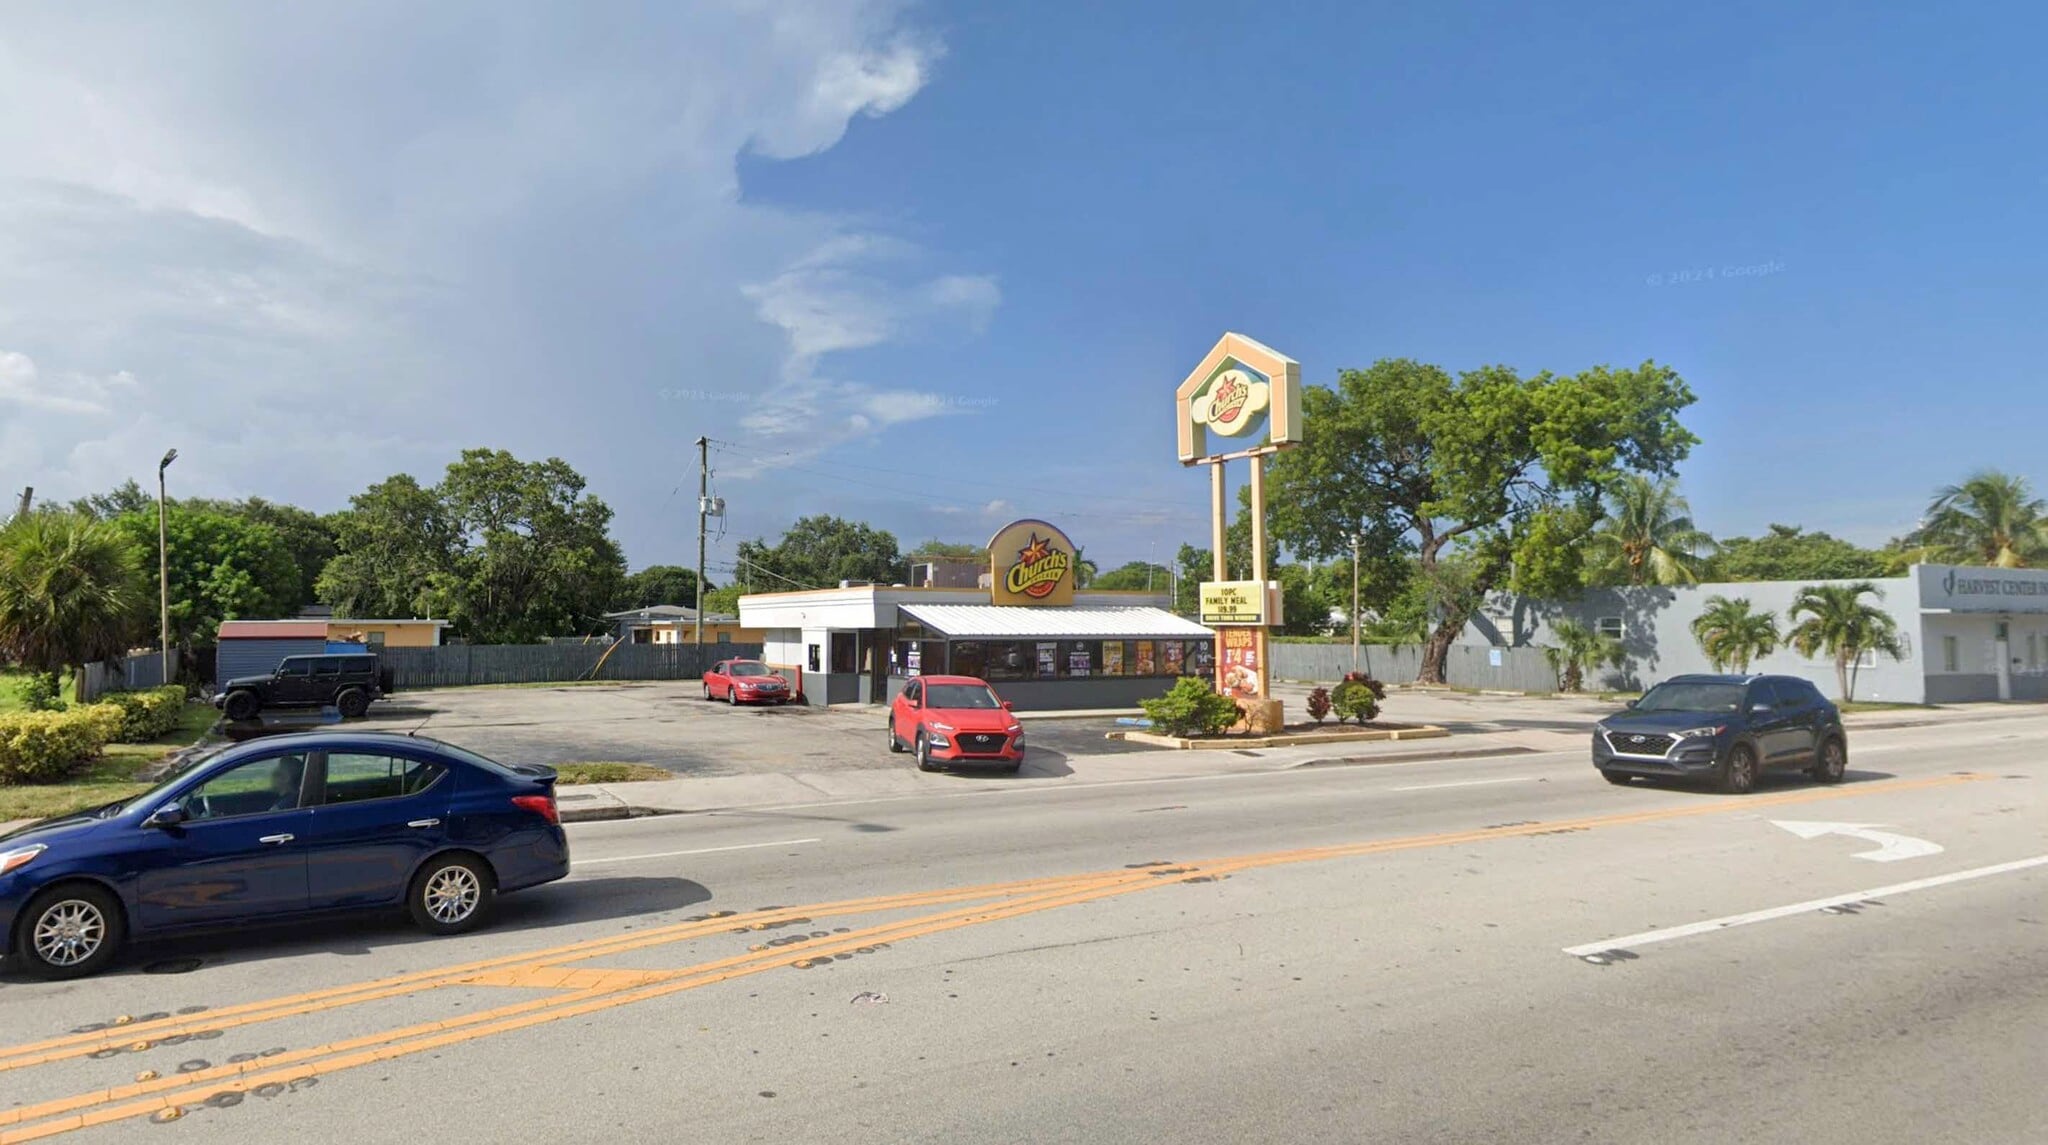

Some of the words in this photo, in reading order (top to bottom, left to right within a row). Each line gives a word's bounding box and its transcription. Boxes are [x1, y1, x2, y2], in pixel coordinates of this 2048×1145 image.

[1208, 383, 1248, 422] Church's
[1006, 548, 1068, 594] Church's
[1221, 588, 1237, 596] 10PC
[1957, 578, 2000, 595] HARVEST
[2002, 579, 2037, 596] CENTER
[1205, 596, 1228, 605] FAMILY
[1230, 596, 1248, 605] MEAL
